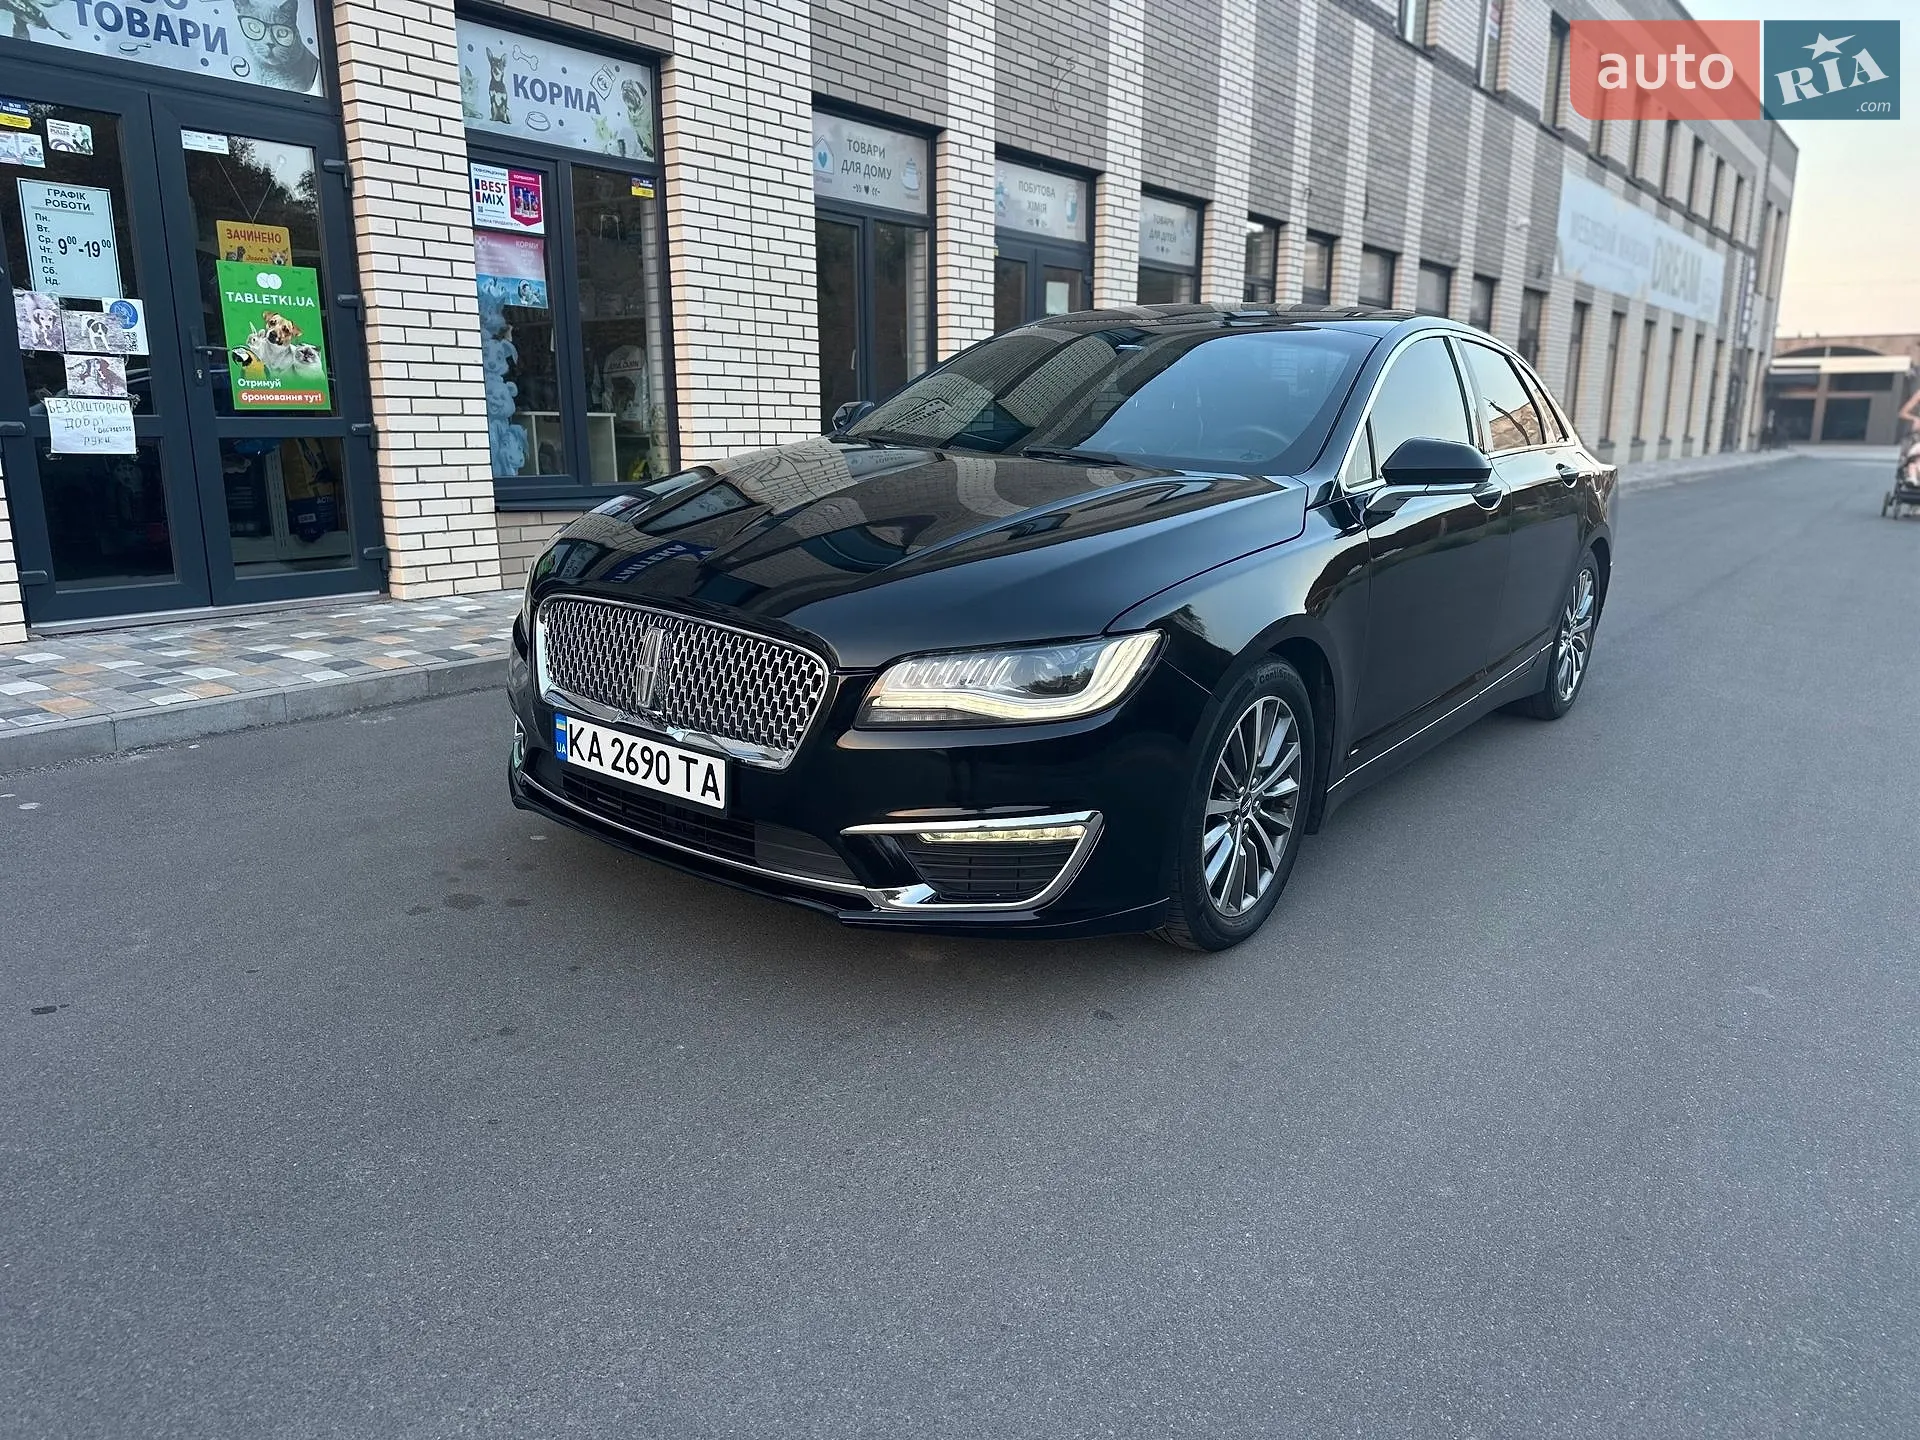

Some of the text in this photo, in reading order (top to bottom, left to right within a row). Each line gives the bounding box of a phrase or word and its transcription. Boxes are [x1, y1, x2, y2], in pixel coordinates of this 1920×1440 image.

[74, 0, 229, 56] ТОВАРИ
[512, 73, 602, 115] КОРМА
[846, 138, 886, 159] ТОВАРИ
[841, 159, 893, 181] ДЛЯ ДОМУ
[481, 179, 507, 195] BEST
[1017, 179, 1056, 199] ПОБУТОВА
[47, 188, 87, 201] ГРАФІК
[481, 193, 505, 207] MIX
[45, 199, 91, 211] РОБОТИ
[1026, 201, 1048, 215] ХІМІЯ
[34, 212, 51, 222] Пн.
[36, 224, 50, 233] Вт.
[38, 234, 54, 245] Ср.
[226, 228, 282, 244] ЗАЧИНЕНО
[39, 245, 53, 254] Чт.
[41, 255, 55, 265] Пт.
[42, 266, 58, 275] Сб.
[45, 277, 61, 286] Нд.
[225, 291, 315, 308] TABLETKI.UA
[237, 377, 282, 389] Отримуй
[241, 392, 322, 403] бронювання тут!
[556, 742, 567, 754] UA
[569, 723, 721, 802] KA 2690 TA
